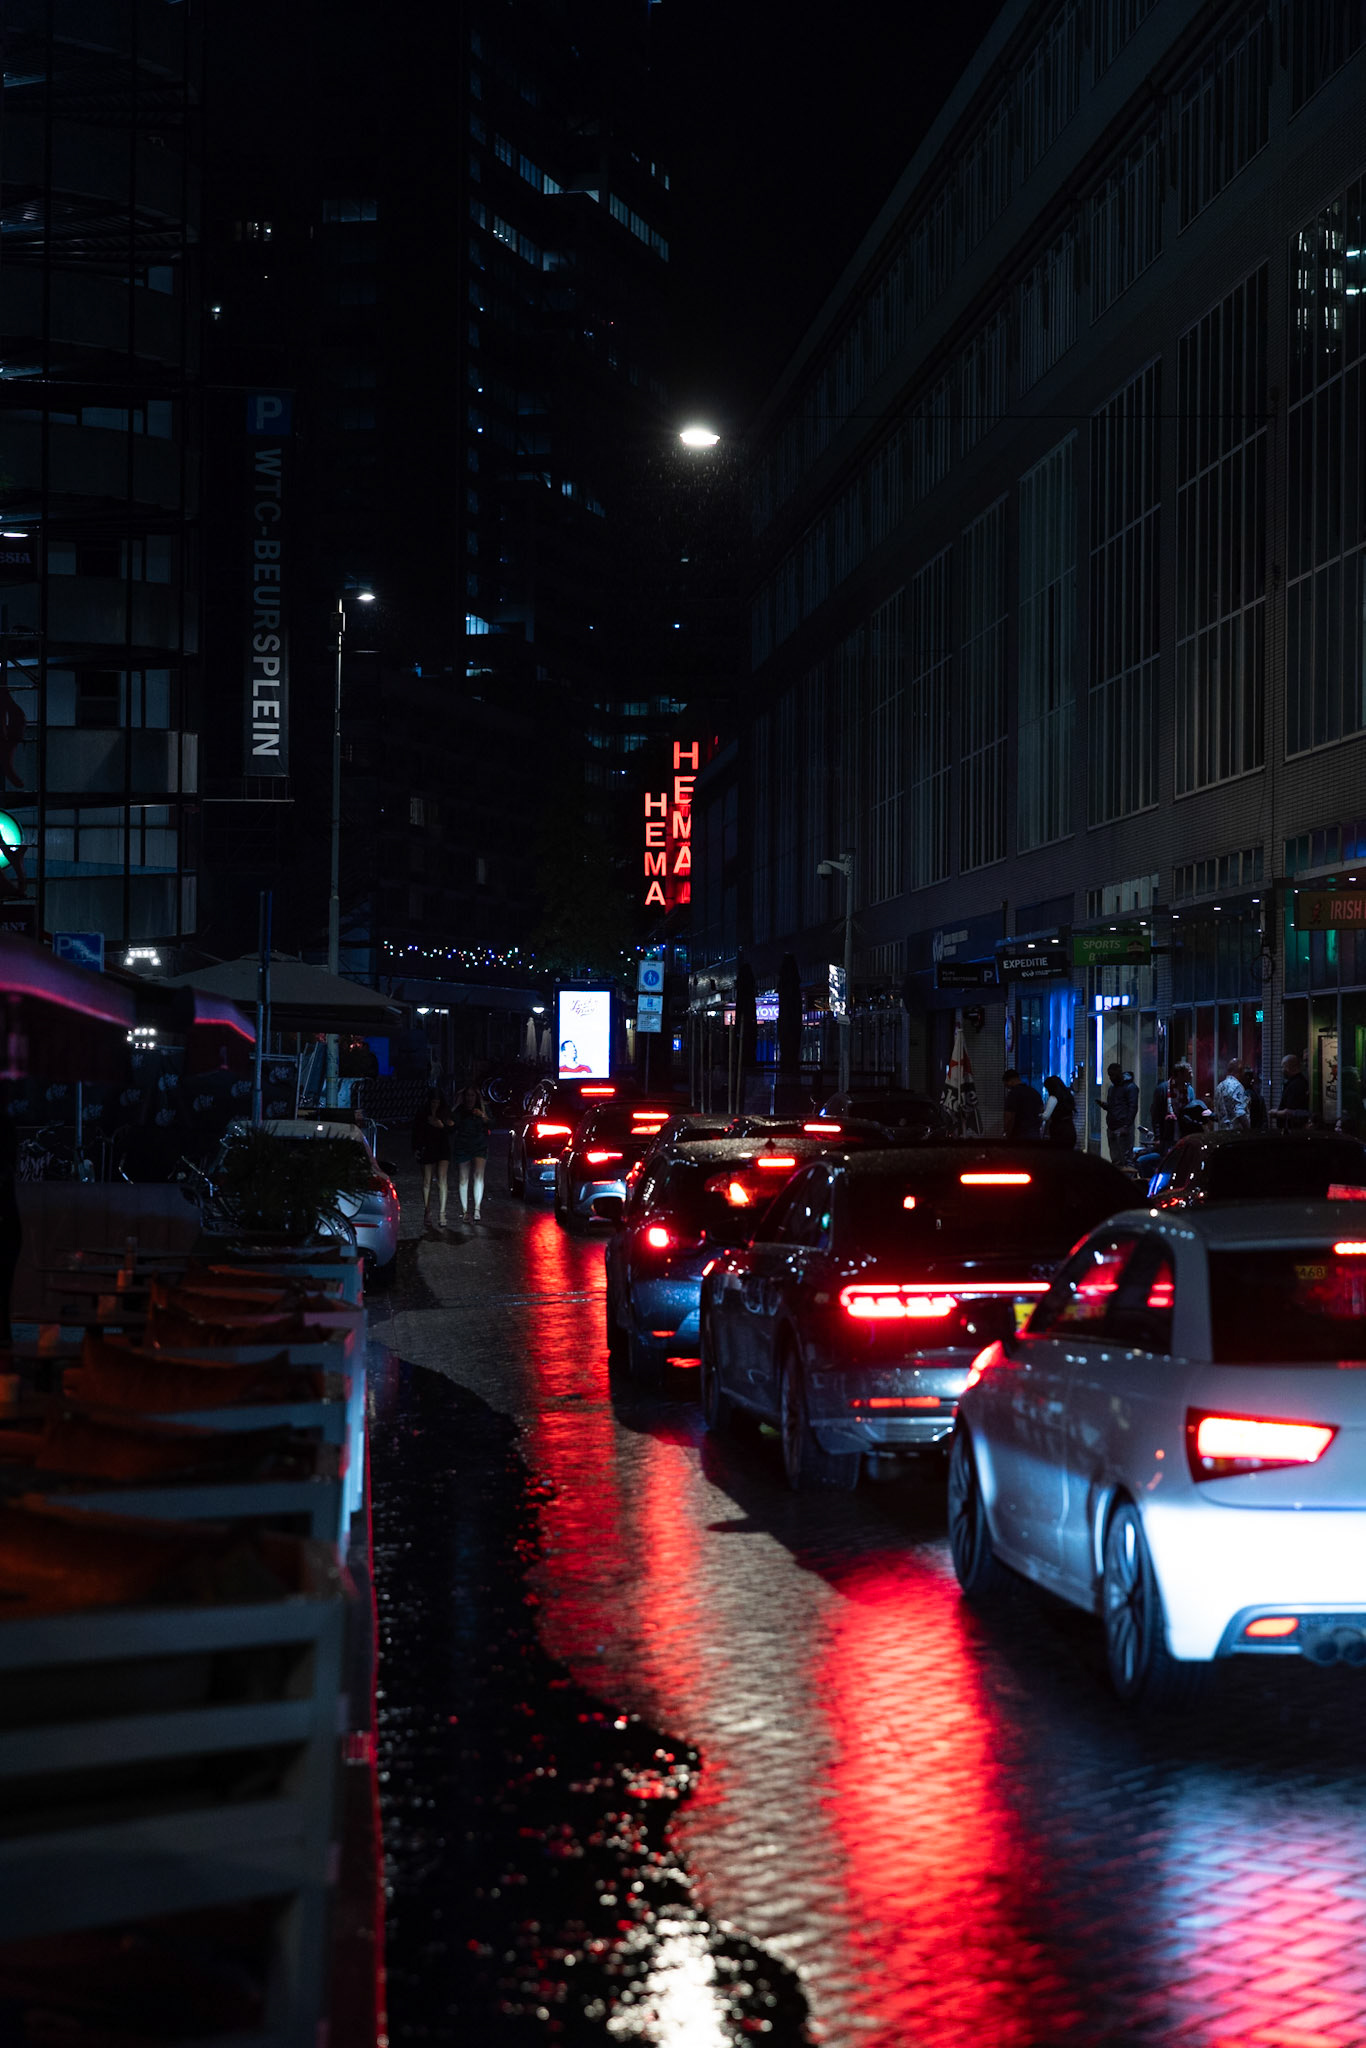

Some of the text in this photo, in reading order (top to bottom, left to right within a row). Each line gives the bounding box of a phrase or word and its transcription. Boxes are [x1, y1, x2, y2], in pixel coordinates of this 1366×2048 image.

[256, 395, 283, 430] P
[252, 447, 283, 756] WTC-BEURSPLEIN
[673, 740, 700, 874] HEMA
[644, 792, 668, 906] HEMA
[1330, 900, 1363, 921] IRISH
[1082, 940, 1120, 949] SPORTS
[983, 970, 994, 983] P
[1003, 956, 1048, 969] EXPEDITIE
